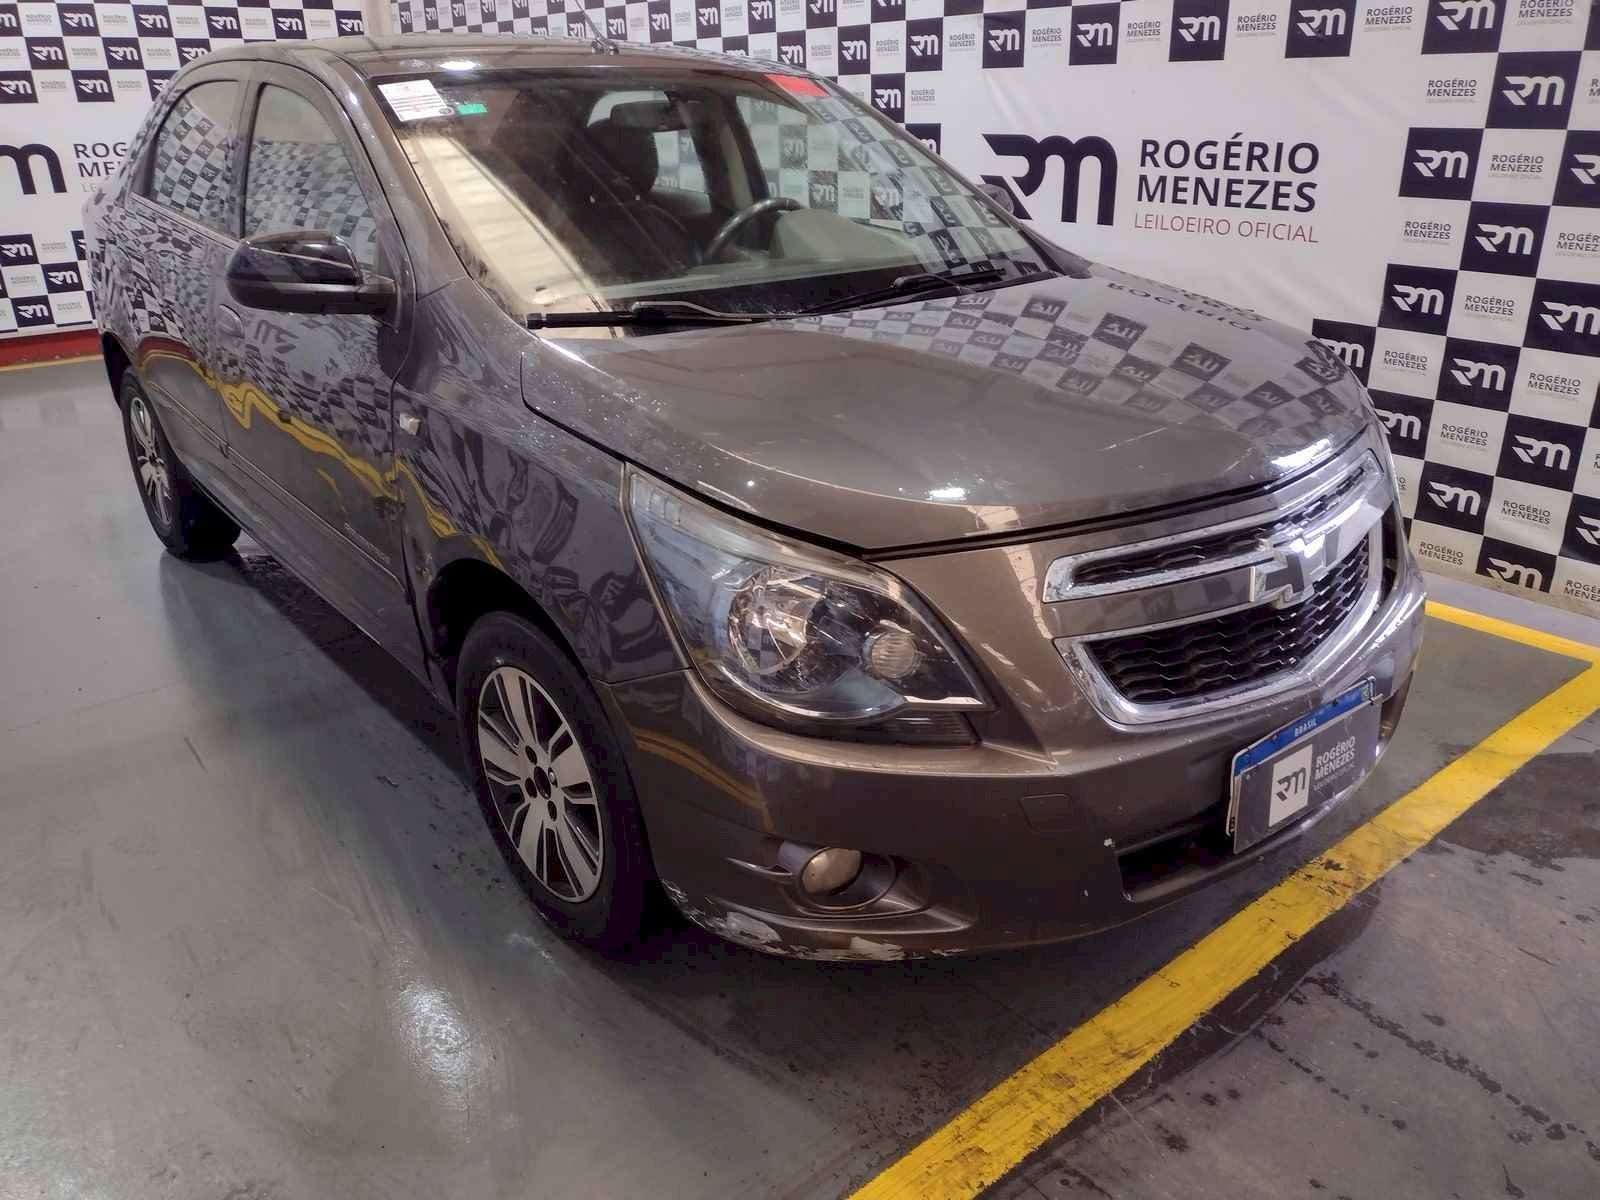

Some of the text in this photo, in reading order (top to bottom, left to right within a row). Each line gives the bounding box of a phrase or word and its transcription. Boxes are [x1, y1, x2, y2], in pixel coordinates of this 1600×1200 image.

[1237, 12, 1277, 23] ROGÉRIO
[1366, 5, 1413, 17] ROGÉRIO
[1127, 20, 1161, 29] ROGÉRIO
[1236, 22, 1276, 32] MENEZES
[1365, 15, 1412, 25] MENEZES
[1127, 28, 1161, 37] MENEZES
[1427, 78, 1477, 88] ROGÉRIO
[1426, 87, 1476, 97] MENEZES
[1138, 132, 1320, 174] ROGÉRIO
[1491, 152, 1544, 164] ROGÉRIO
[1490, 163, 1544, 173] MENEZES
[1136, 174, 1318, 213] MENEZES
[1134, 213, 1319, 244] LEILOEIRO OFICIAL
[1405, 220, 1451, 232] ROGÉRIO
[1403, 229, 1451, 240] MENEZES
[1558, 232, 1600, 244] ROGÉR
[1556, 241, 1600, 253] MENEZ
[1465, 294, 1515, 308] ROGÉRIO
[1464, 303, 1514, 316] MENEZES
[1384, 350, 1428, 363] ROGÉRIO
[1383, 357, 1428, 371] MENEZES
[1529, 372, 1581, 387] ROGÉRIO
[1527, 380, 1580, 397] MENEZES
[1442, 423, 1489, 439] ROGÉRIO
[1440, 431, 1488, 447] MENEZES
[1503, 500, 1551, 517] ROGÉRIO
[1501, 508, 1551, 525] MENEZES
[1420, 541, 1464, 559] ROGÉRIO
[1418, 548, 1464, 567] MENEZES
[1563, 587, 1600, 602] MENE
[1566, 580, 1600, 595] ROGÉ
[1294, 718, 1317, 737] BRASIL
[1316, 736, 1356, 768] ROGÉRIO
[1314, 748, 1356, 781] MENEZES
